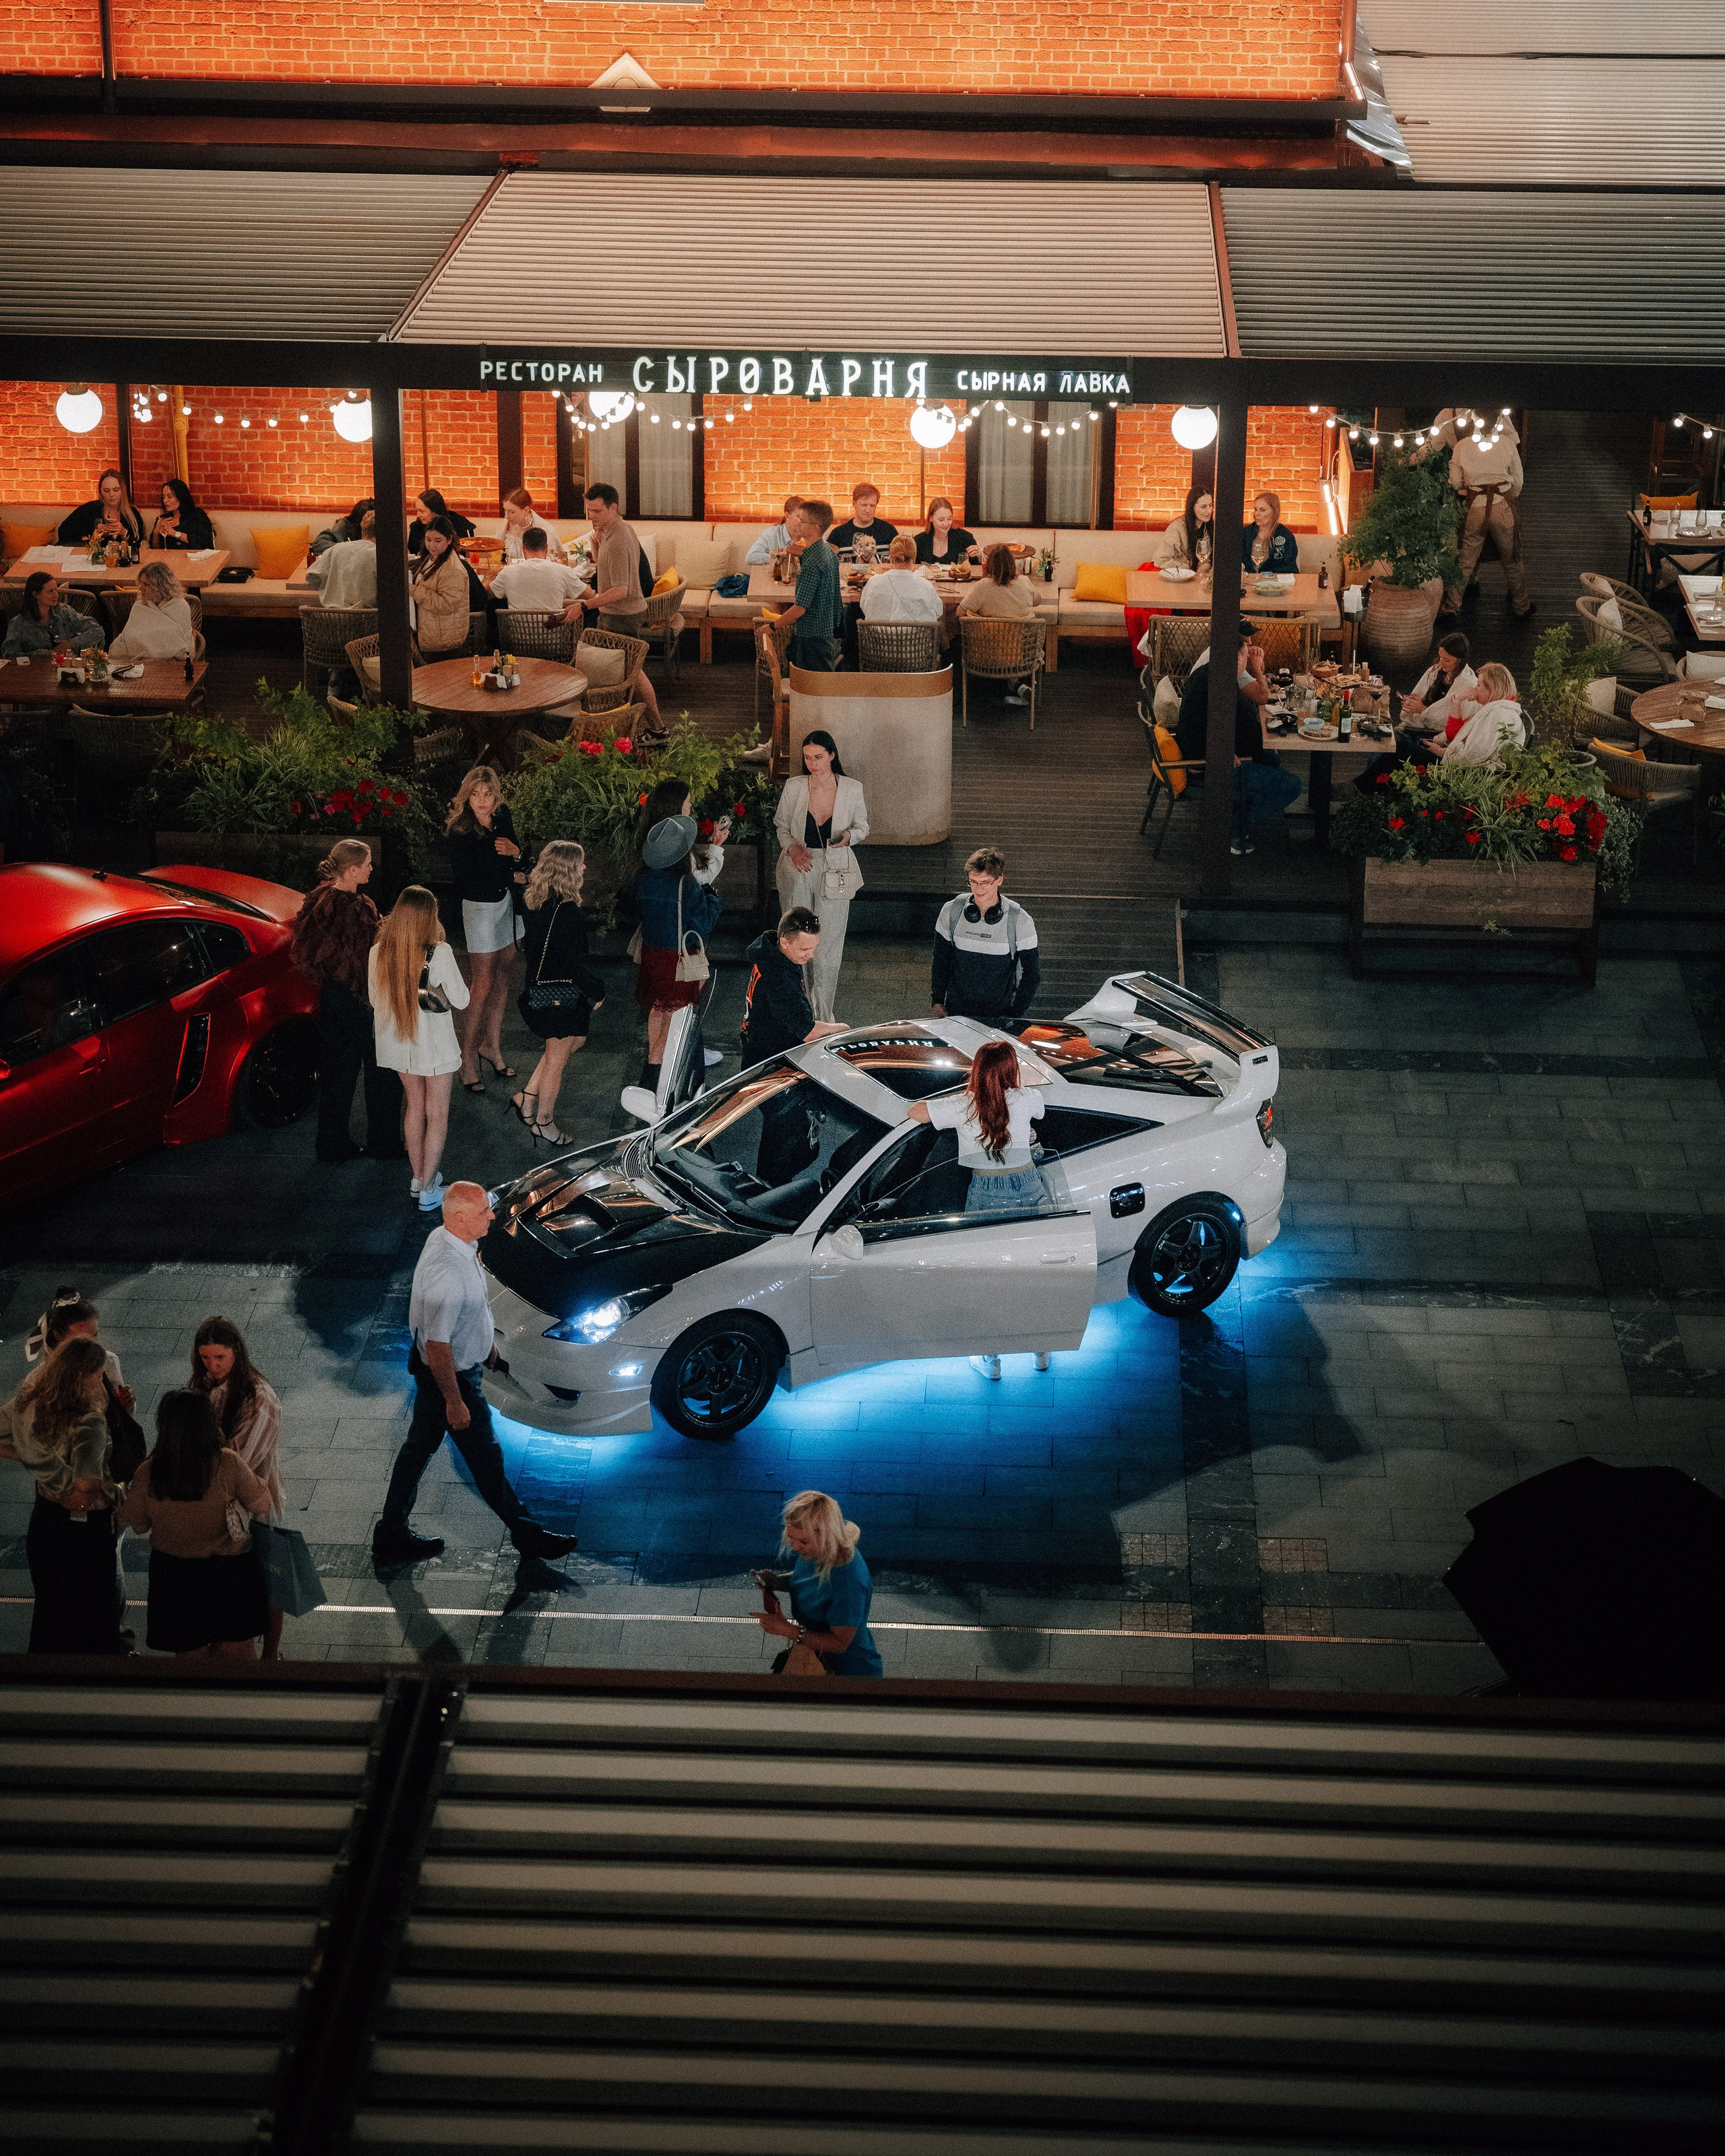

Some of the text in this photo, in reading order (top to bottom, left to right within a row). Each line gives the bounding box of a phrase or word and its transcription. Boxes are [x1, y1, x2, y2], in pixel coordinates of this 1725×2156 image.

[480, 360, 603, 383] РЕСТОРАН
[632, 354, 929, 399] СЫРОВАРНЯ
[957, 370, 1131, 393] СЫРНАЯ ЛАВКА
